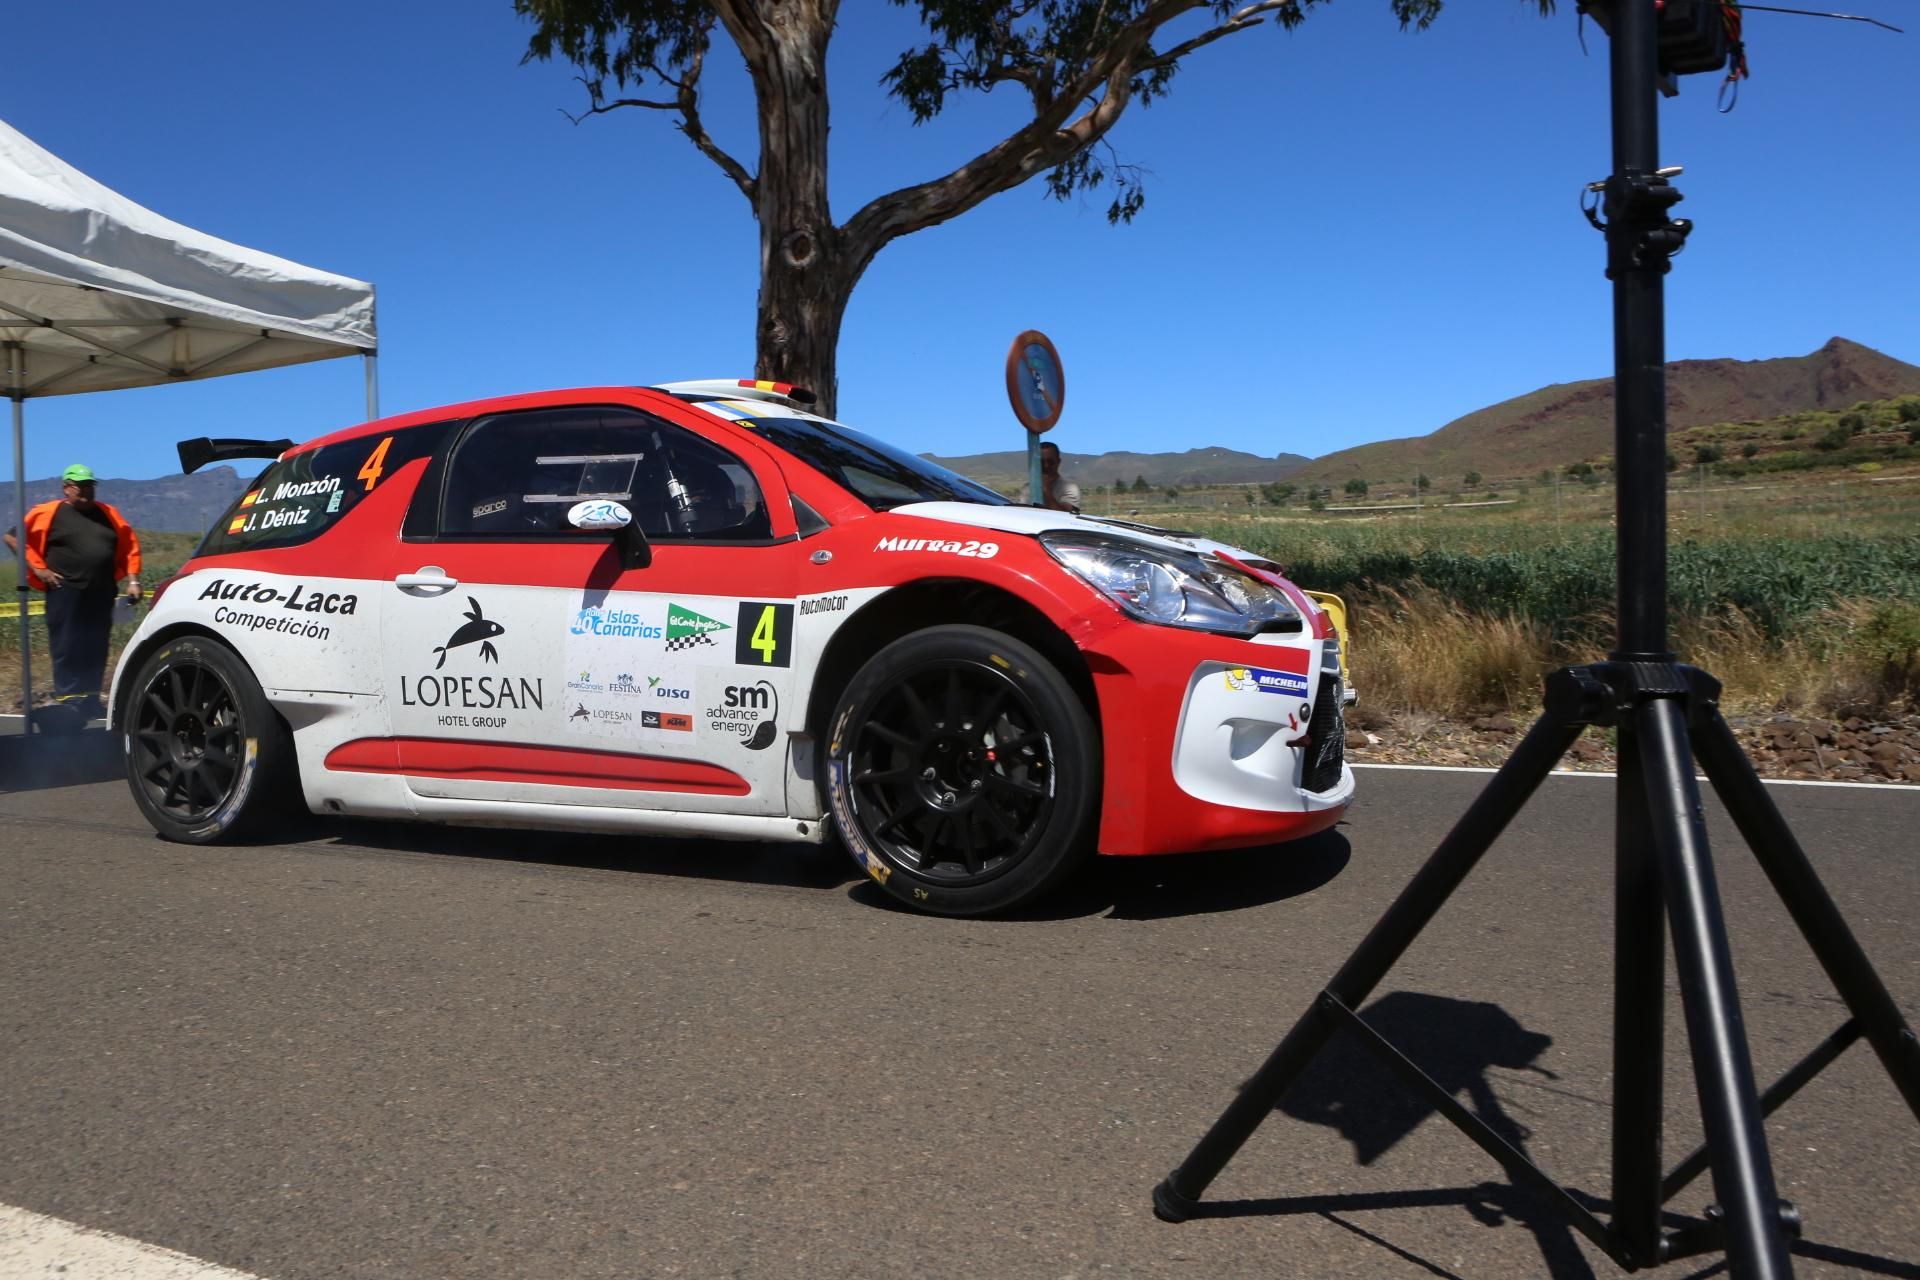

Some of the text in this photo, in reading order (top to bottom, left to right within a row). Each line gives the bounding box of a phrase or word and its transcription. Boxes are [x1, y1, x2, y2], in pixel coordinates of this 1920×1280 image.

[357, 437, 394, 491] 4
[255, 475, 341, 505] L. Monzón
[243, 506, 310, 532] J. Déniz
[873, 536, 1000, 559] Murga29
[198, 579, 358, 616] Auto-Laca
[214, 606, 331, 641] Competición
[606, 609, 640, 625] Islas
[593, 620, 662, 639] Canarias
[750, 605, 777, 663] 4
[401, 675, 544, 711] LOPESAN
[609, 683, 642, 694] FESTINA
[1259, 675, 1308, 690] MICHELIN
[724, 684, 769, 709] sm
[438, 715, 507, 728] HOTEL GROUP
[593, 709, 632, 721] LOPESAN
[706, 705, 759, 721] advance
[711, 720, 755, 736] energy
